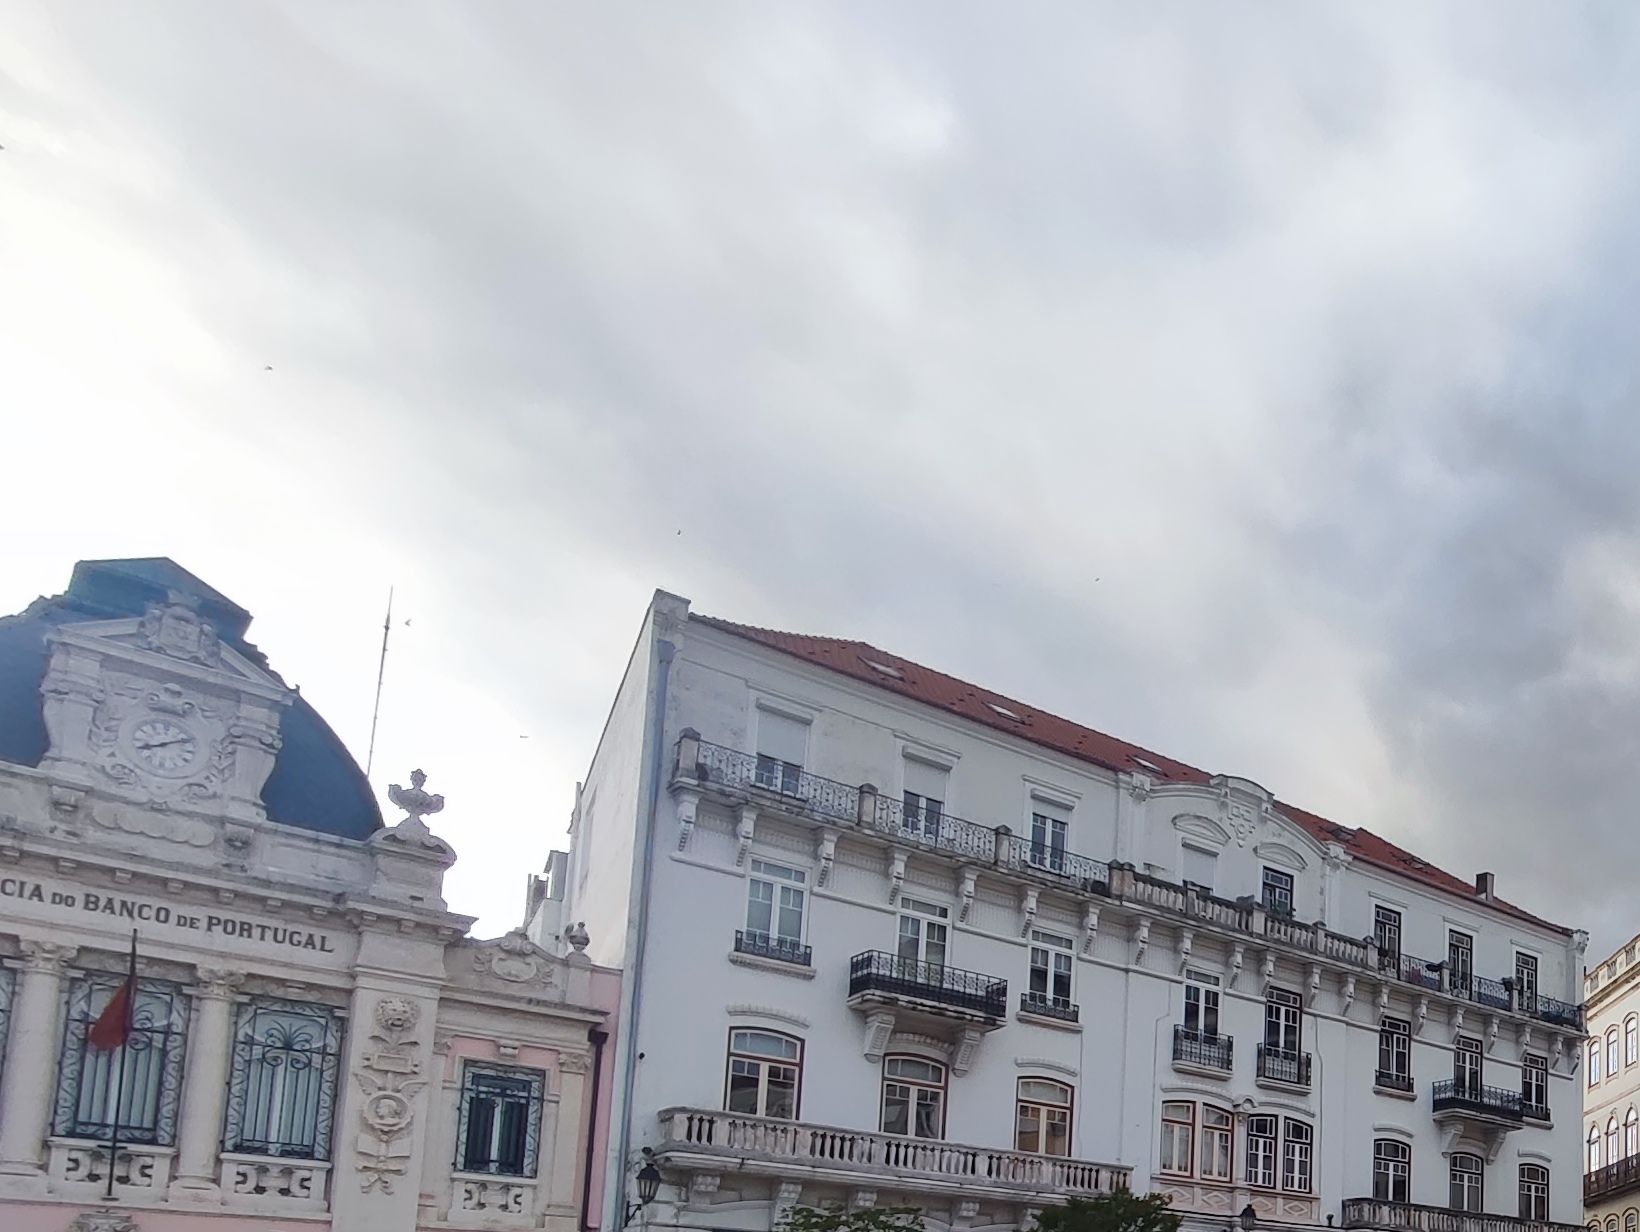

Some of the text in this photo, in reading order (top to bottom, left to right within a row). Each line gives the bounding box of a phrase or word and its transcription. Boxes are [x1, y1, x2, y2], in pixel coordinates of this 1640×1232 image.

[83, 892, 171, 923] BANCO
[175, 913, 200, 930] DE
[206, 914, 335, 953] PORTUGAL
